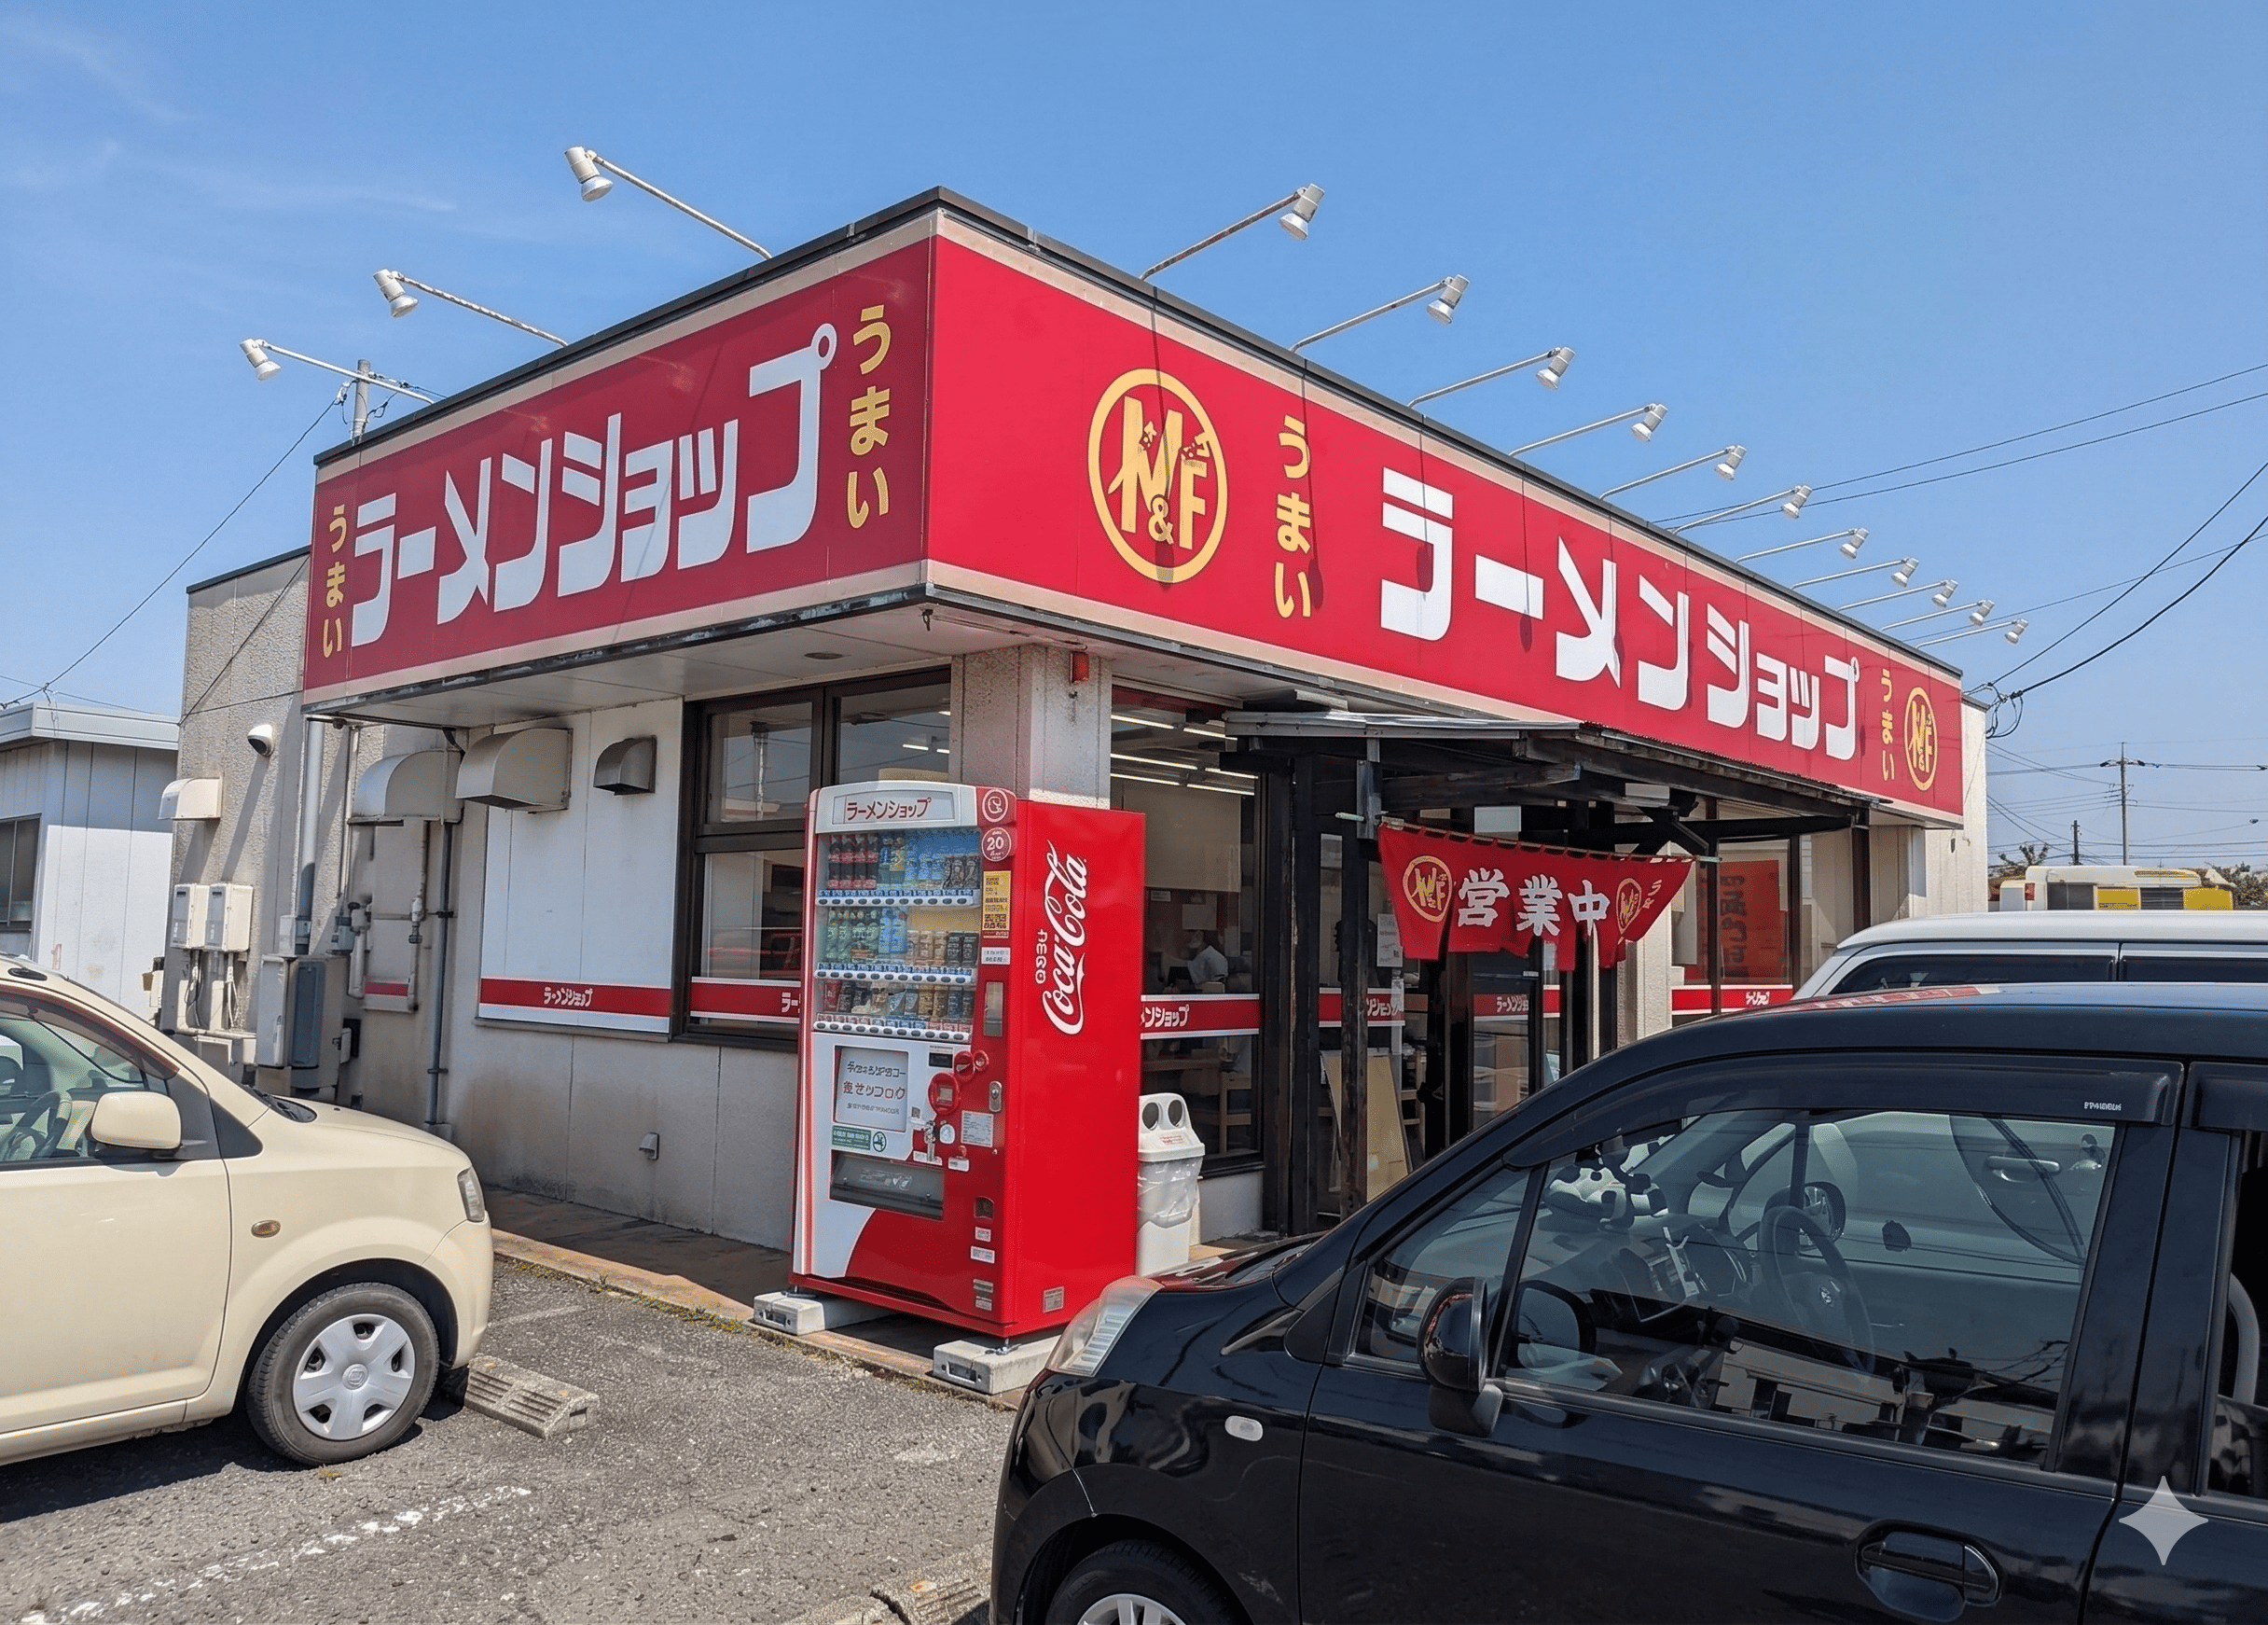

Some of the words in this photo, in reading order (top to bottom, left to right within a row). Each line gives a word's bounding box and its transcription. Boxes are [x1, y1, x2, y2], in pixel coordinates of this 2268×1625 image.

[352, 323, 837, 647] ラーメンショップ
[847, 304, 891, 529] うまい
[323, 504, 347, 658] うまい
[1275, 414, 1312, 618] うまい
[1380, 466, 1860, 761] ラーメンショップ
[847, 797, 932, 821] ラーメンショップ
[987, 836, 1004, 851] 20
[1458, 867, 1611, 937] 営業中
[1042, 839, 1087, 1035] Coca-Cola
